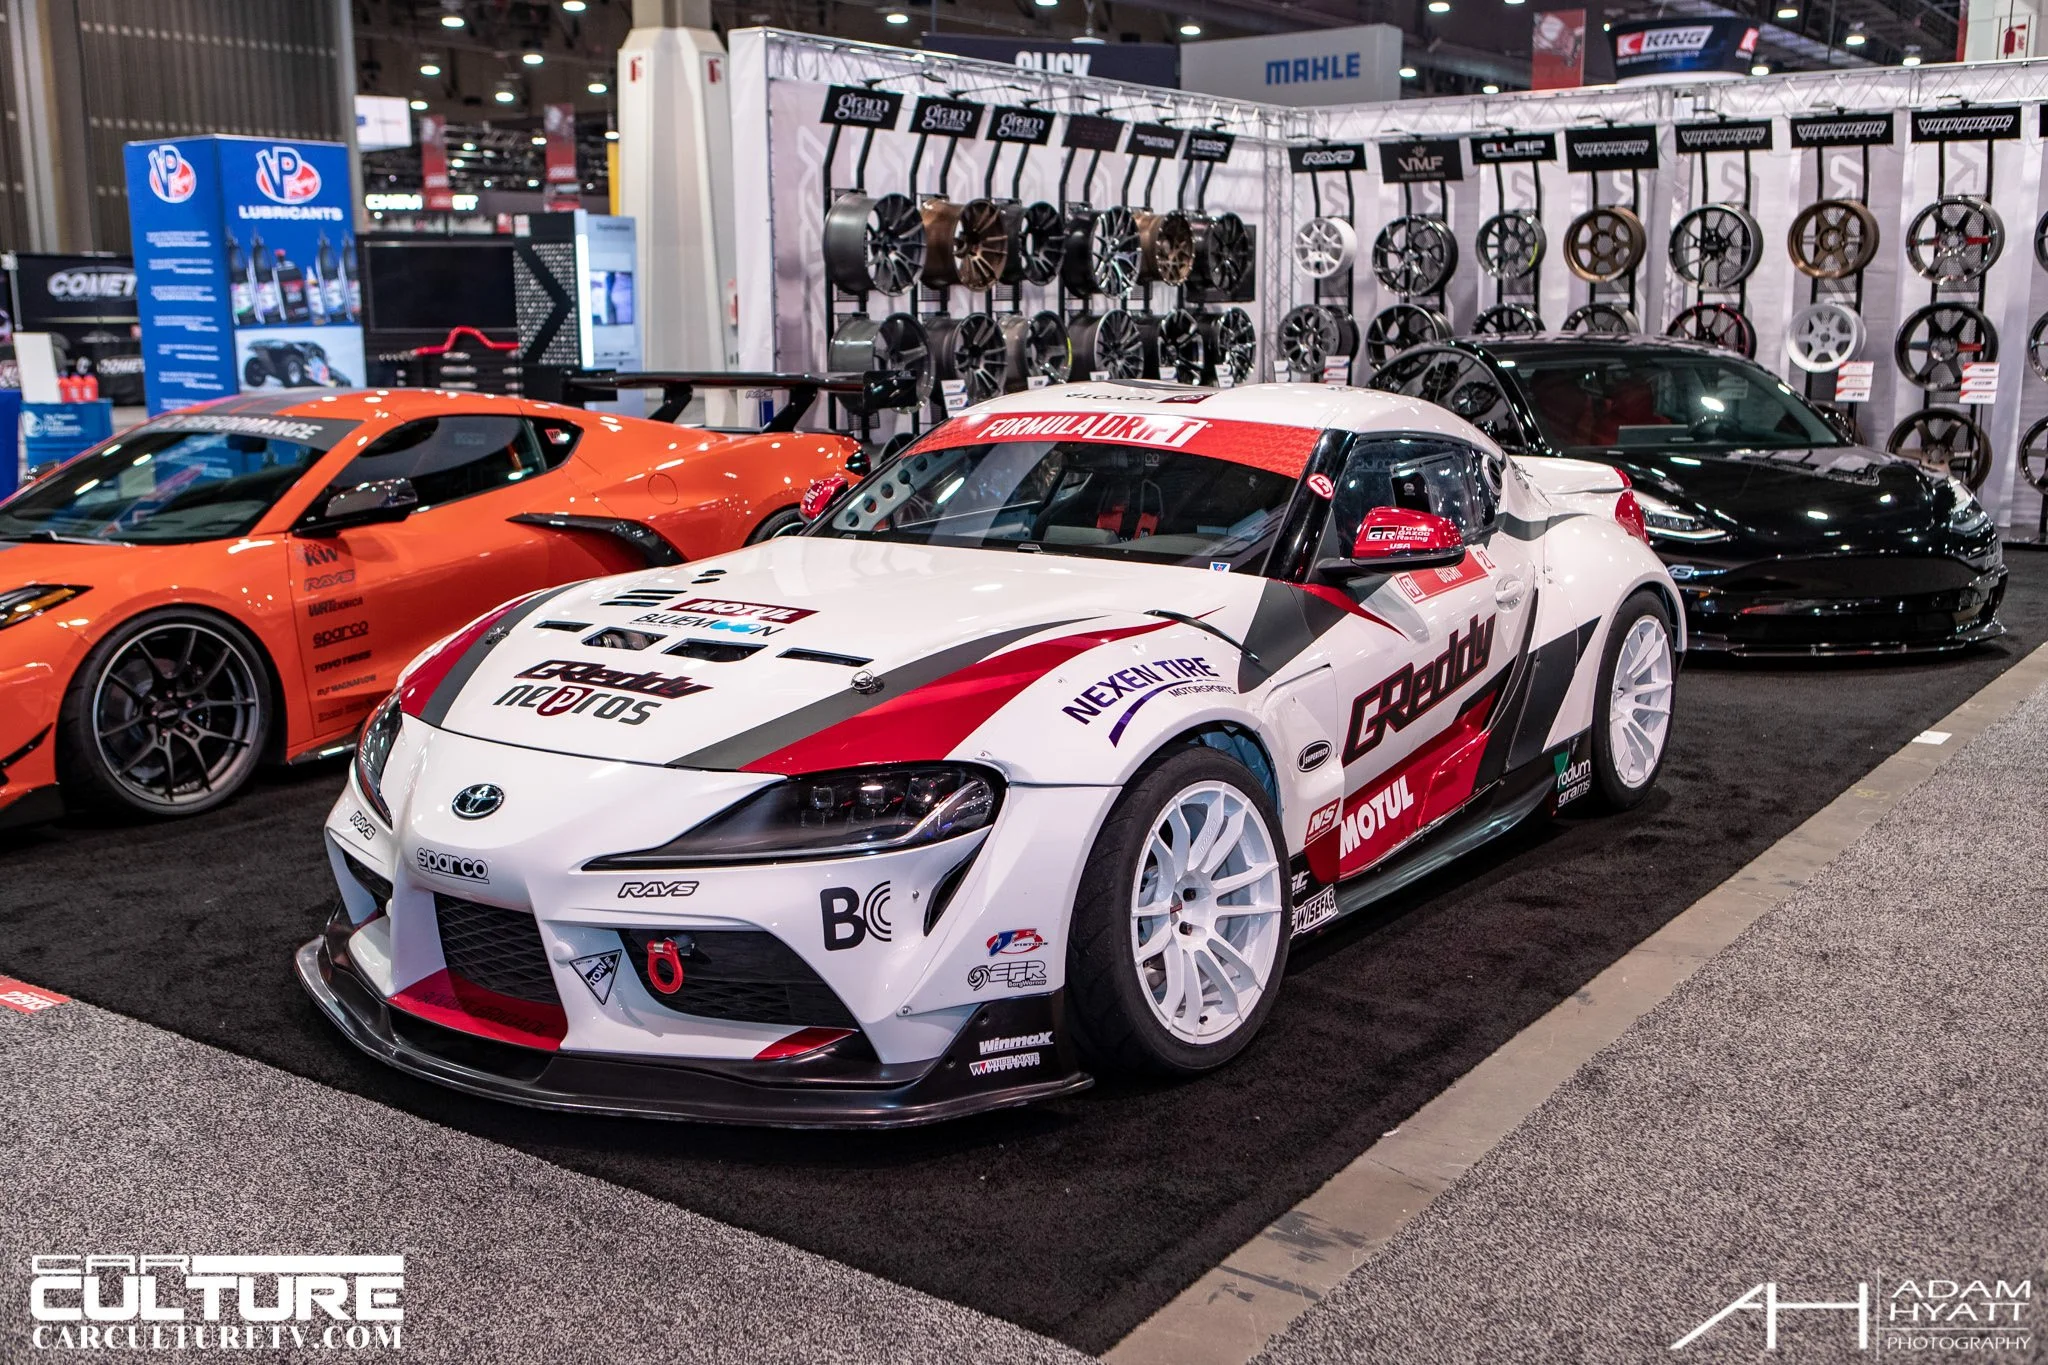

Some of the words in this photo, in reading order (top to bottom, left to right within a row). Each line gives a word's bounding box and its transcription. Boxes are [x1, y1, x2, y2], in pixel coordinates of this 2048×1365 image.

[1646, 30, 1705, 48] KING
[1265, 52, 1361, 85] MAHLE
[834, 91, 890, 120] gram
[921, 103, 973, 129] gram
[997, 112, 1045, 137] gram
[1302, 150, 1356, 166] RAYS
[1398, 155, 1444, 172] VMF
[238, 205, 344, 221] LUBRICANTS
[47, 272, 138, 297] COMET
[976, 415, 1096, 439] FORMULA
[1094, 414, 1206, 447] DRIFT
[1368, 530, 1396, 541] GR
[304, 547, 339, 567] KW
[1476, 550, 1497, 570] 21
[304, 569, 356, 592] RAYS
[679, 600, 796, 621] MOTUL
[312, 620, 369, 649] sparco
[314, 656, 342, 674] TOYO
[513, 659, 715, 699] GReddy
[1061, 664, 1165, 726] NEXEN
[1152, 657, 1221, 680] TIRE
[1168, 684, 1237, 698] MOTORSPORTS
[1341, 612, 1497, 769] GReddy
[492, 685, 663, 726] nepros
[1557, 780, 1591, 808] grams
[350, 809, 377, 841] RAYS
[1308, 803, 1337, 836] NS
[1339, 774, 1415, 861] MOTUL
[416, 846, 490, 884] sparco
[617, 880, 701, 899] RAYS
[820, 880, 892, 952] BC
[588, 960, 608, 987] TOW
[989, 960, 1047, 983] EFR
[1007, 979, 1047, 989] BorgWarner
